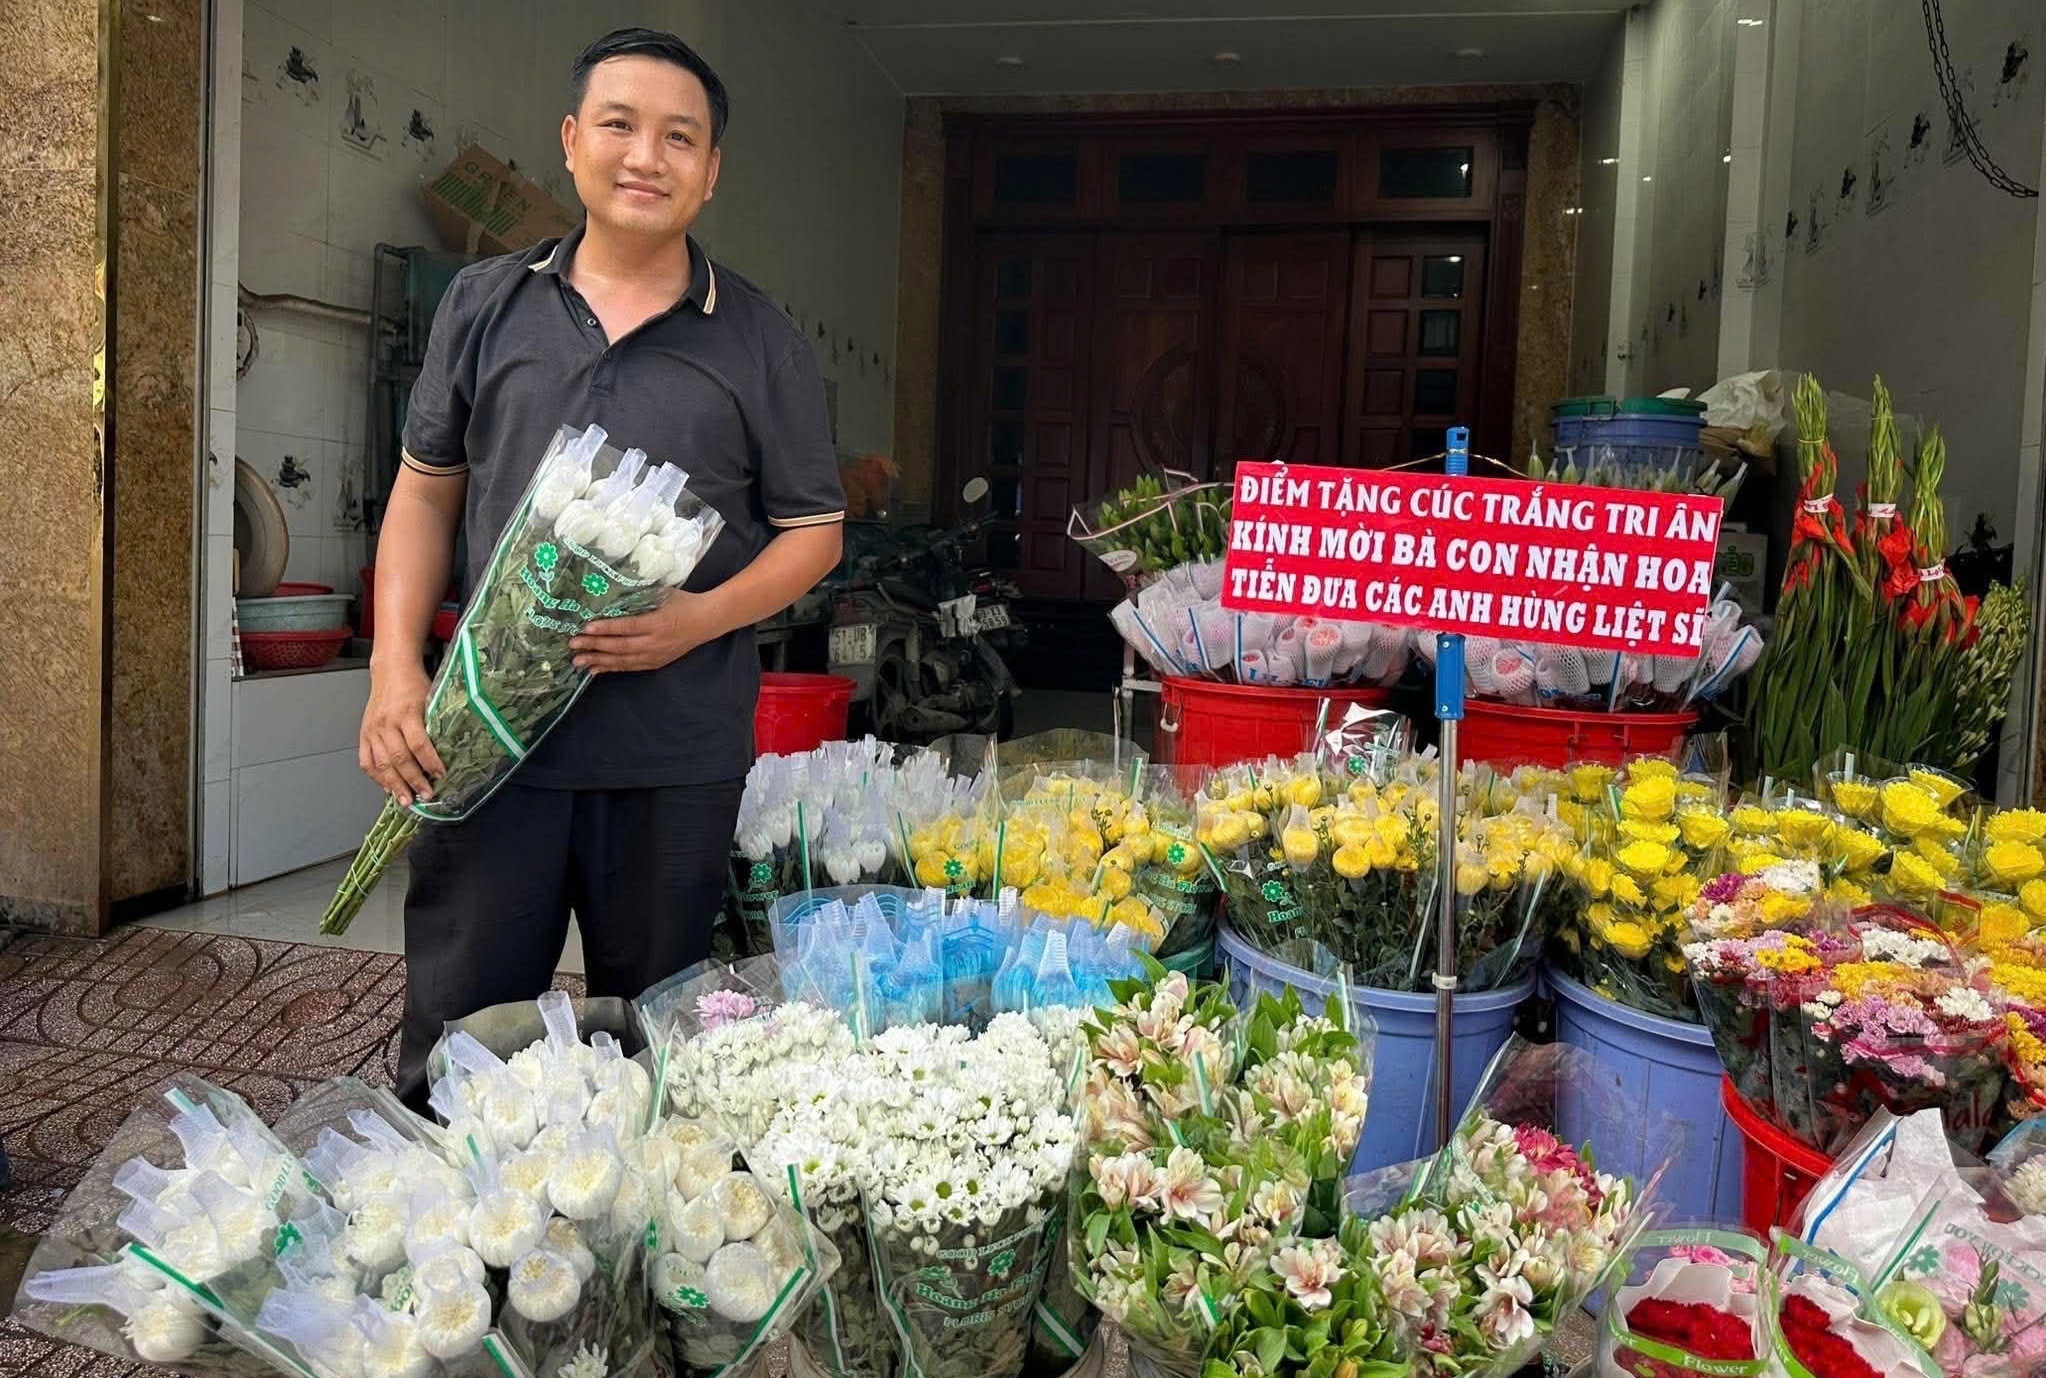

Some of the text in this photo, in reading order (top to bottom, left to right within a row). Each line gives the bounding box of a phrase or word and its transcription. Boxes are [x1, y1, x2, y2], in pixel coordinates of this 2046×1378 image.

[1240, 466, 1718, 542] ĐIỂM TẶNG CÚC TRẮNG TRI ÂN
[1231, 514, 1313, 556] KÍNH
[1318, 522, 1386, 563] MỜI
[1391, 528, 1437, 568] BÀ
[1446, 538, 1519, 576] CON
[1525, 543, 1628, 592] NHẬN
[1634, 555, 1711, 595] HOA
[1231, 558, 1705, 647] TIỄN ĐƯA CÁC ANH HÙNG LIỆT SĨ
[1682, 1354, 1748, 1374] Flower
